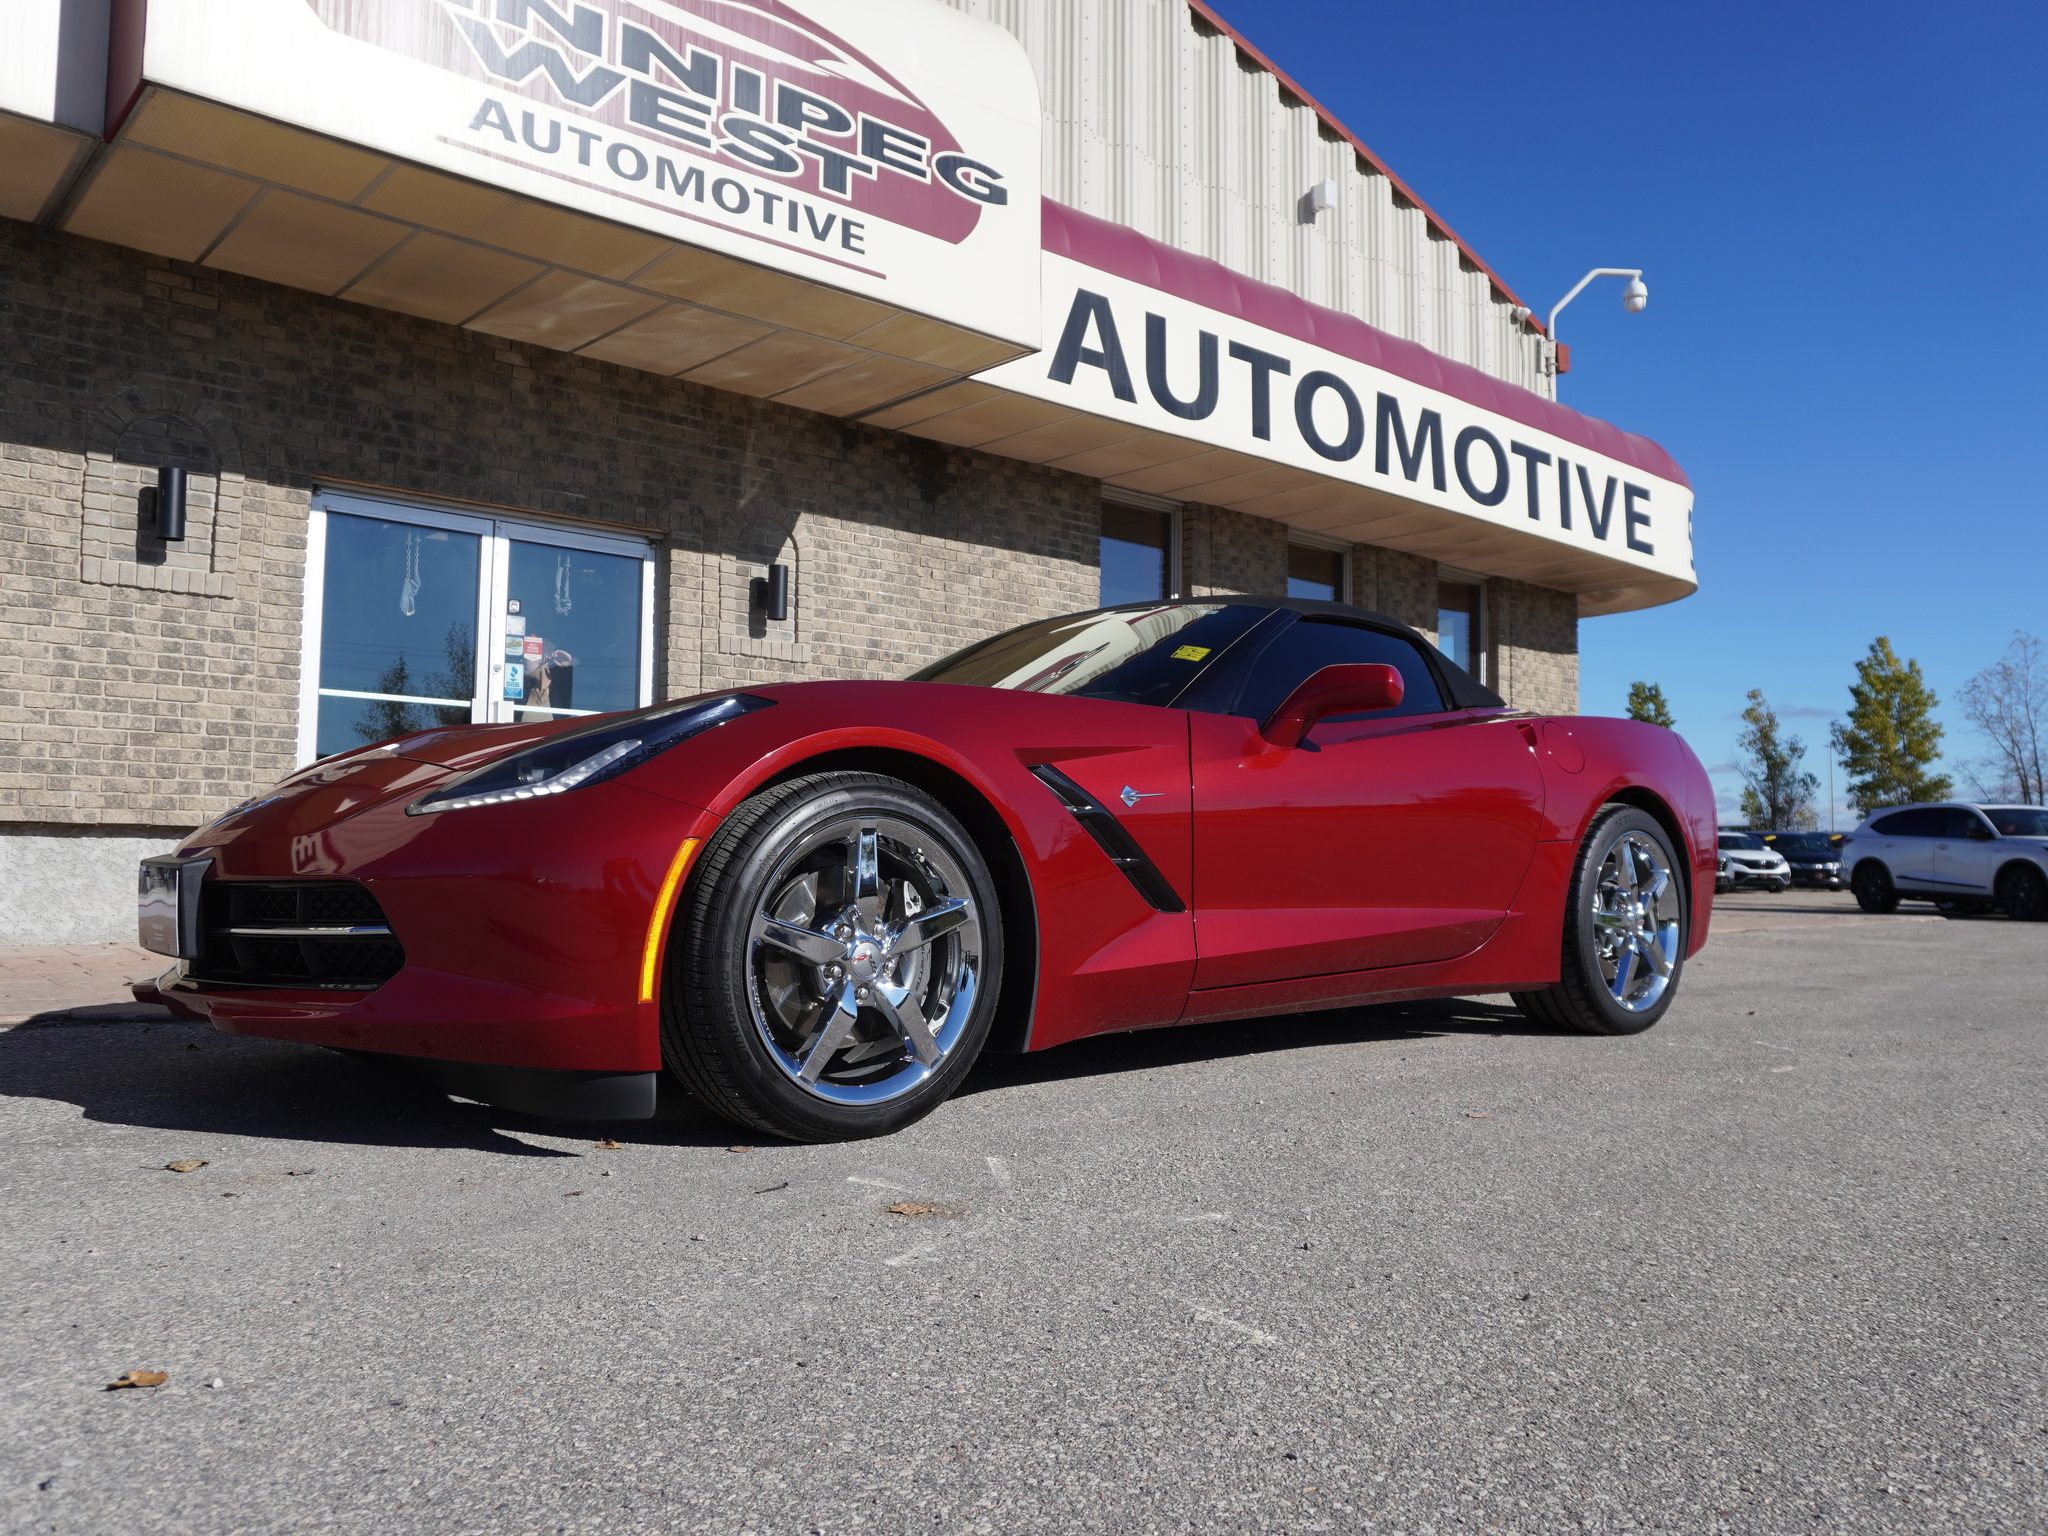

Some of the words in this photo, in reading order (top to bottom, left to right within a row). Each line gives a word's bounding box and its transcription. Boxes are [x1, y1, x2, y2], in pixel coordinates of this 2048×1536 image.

[446, 0, 1008, 206] NNIPEG
[452, 11, 874, 196] WEST
[468, 98, 866, 255] AUTOMOTIVE
[1047, 288, 1655, 556] AUTOMOTIVE
